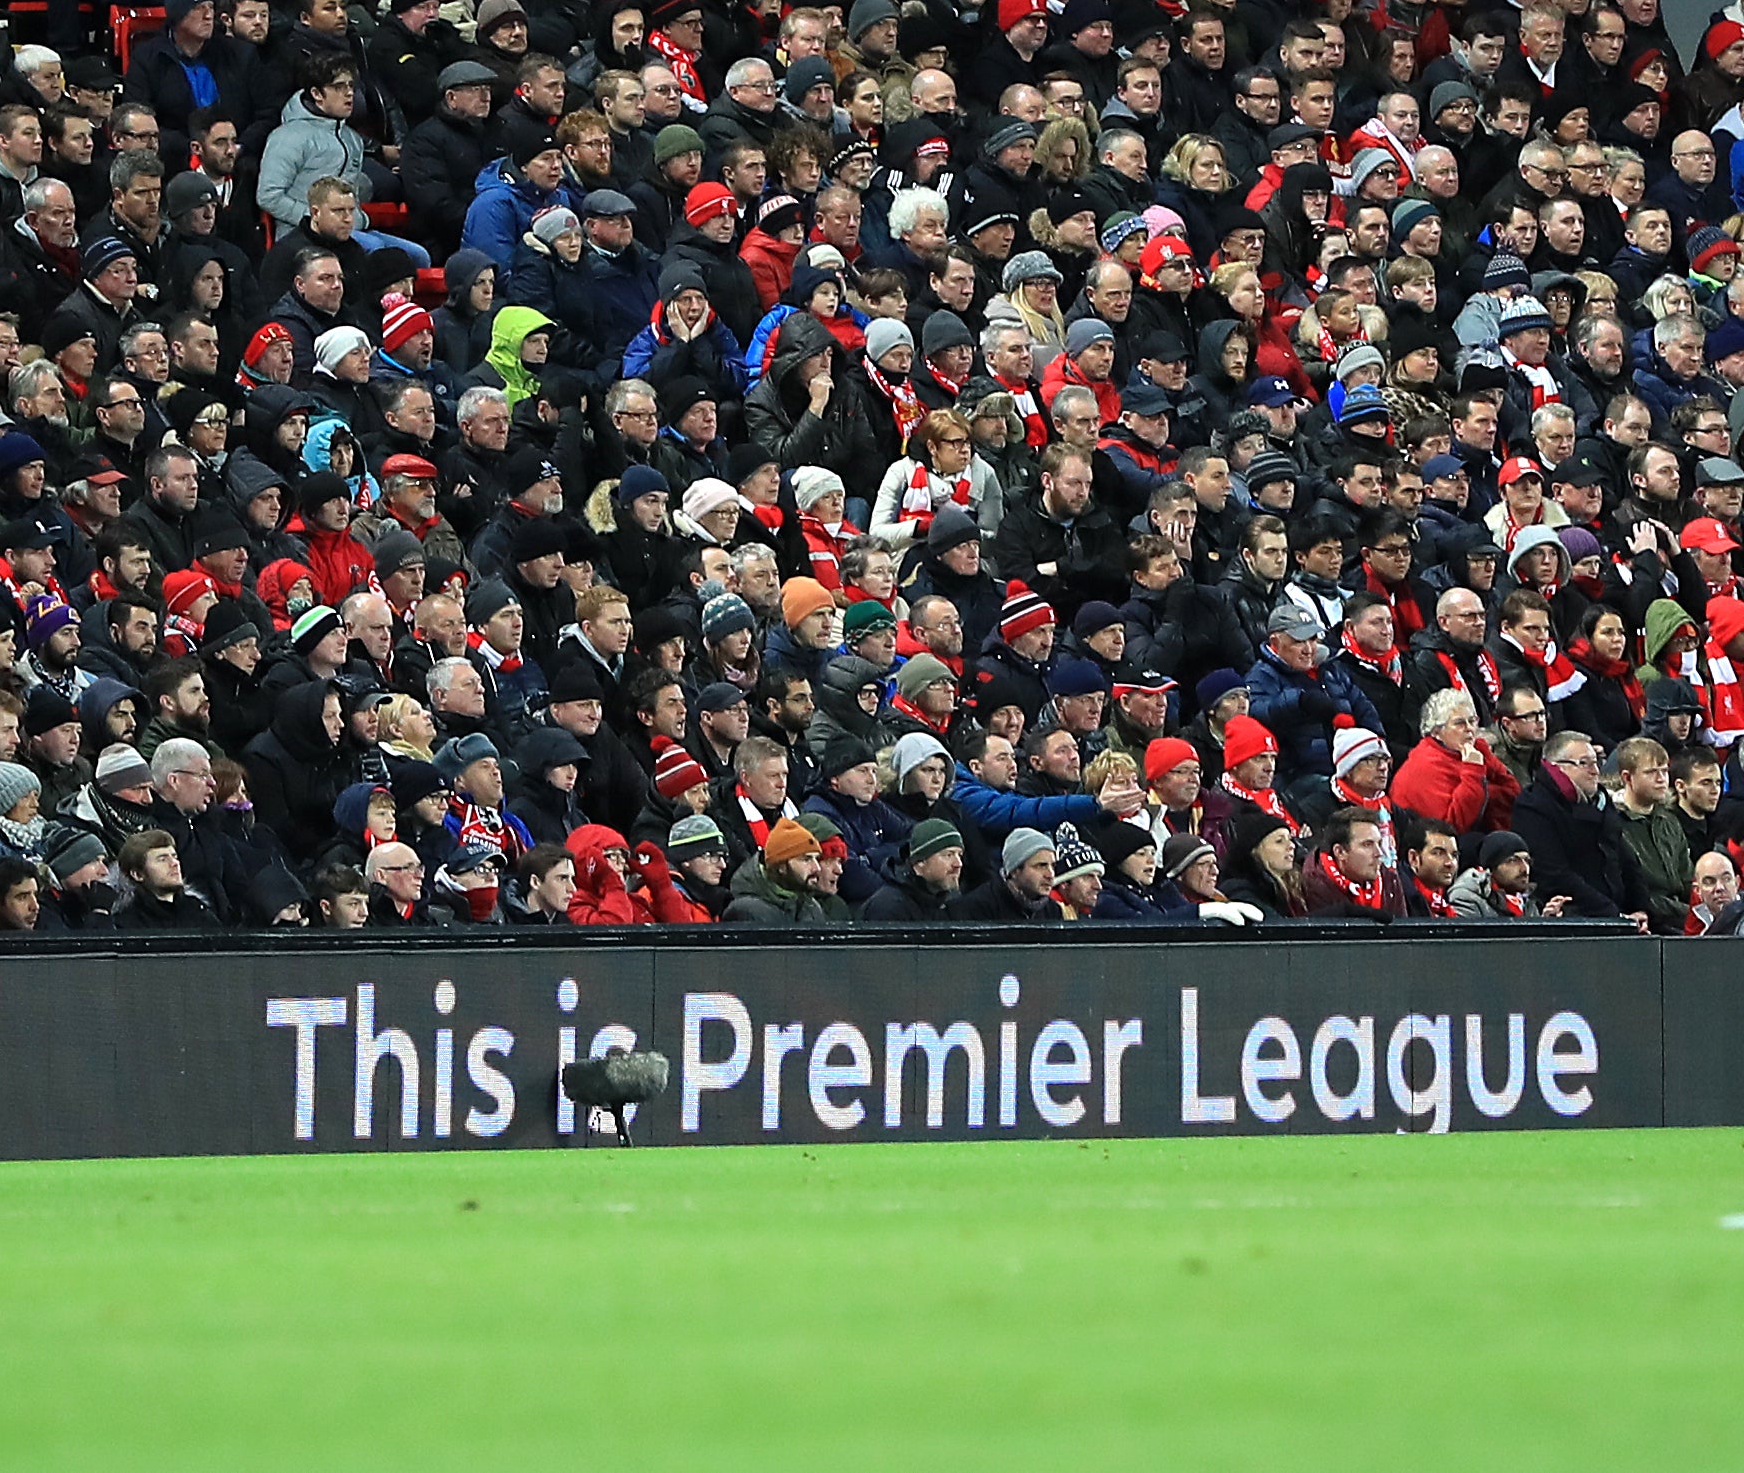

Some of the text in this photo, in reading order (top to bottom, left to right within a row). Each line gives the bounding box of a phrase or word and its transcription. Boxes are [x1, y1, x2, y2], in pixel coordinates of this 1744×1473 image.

[265, 980, 516, 1140] This
[680, 976, 1144, 1133] Premier
[1180, 987, 1599, 1136] League
